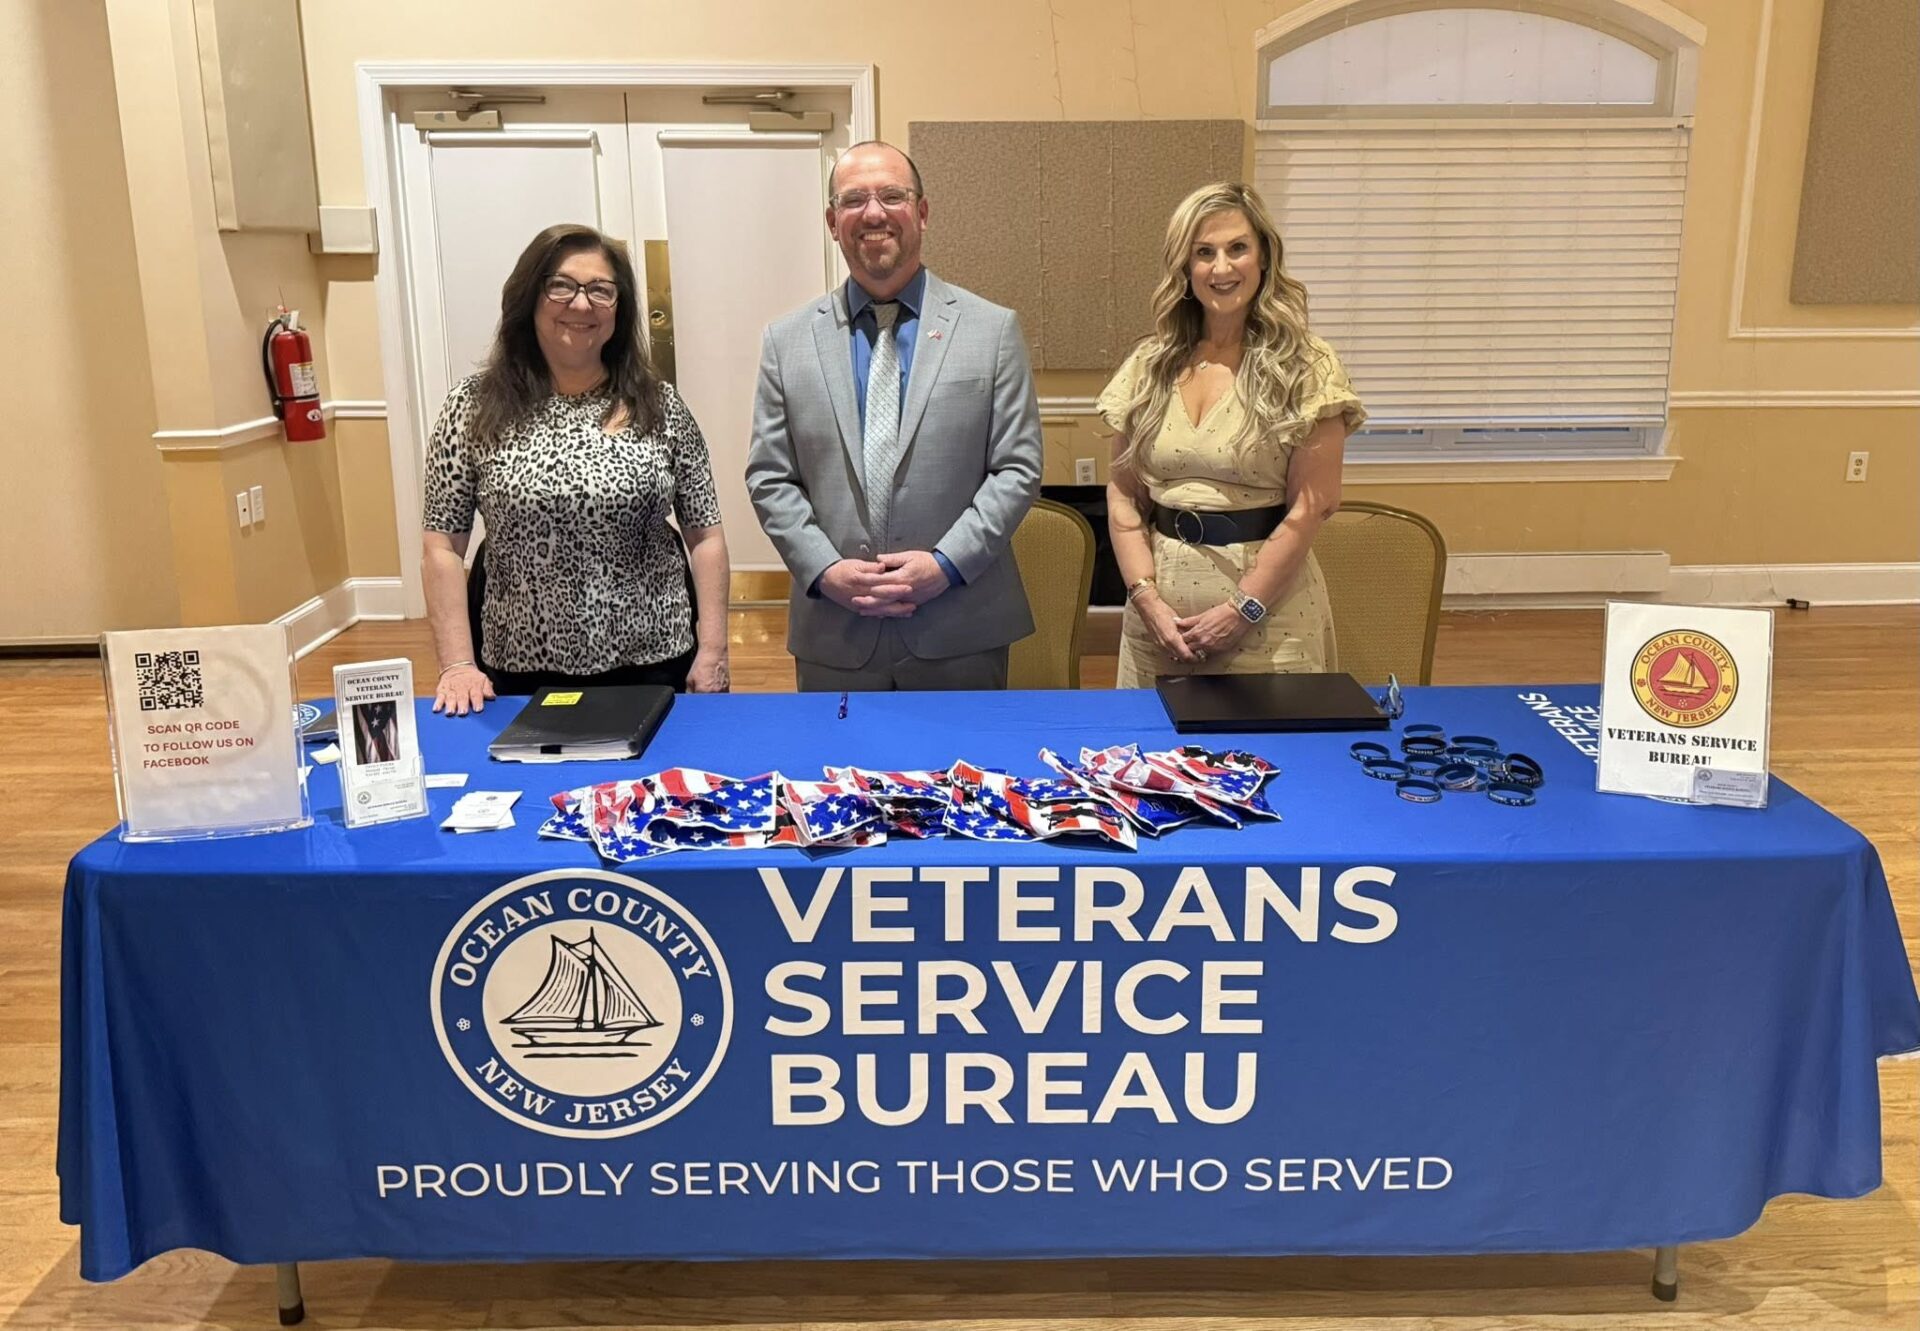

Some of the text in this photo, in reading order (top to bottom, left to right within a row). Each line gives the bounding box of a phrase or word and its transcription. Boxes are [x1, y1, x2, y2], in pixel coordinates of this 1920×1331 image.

[1641, 635, 1679, 665] OCEAN
[356, 684, 392, 692] VETERANS
[1646, 698, 1673, 718] NEW
[147, 720, 240, 735] SCAN QR CODE
[1607, 728, 1757, 752] VETERANS SERVICE
[144, 737, 254, 752] TO FOLLOW US ON
[1648, 750, 1712, 766] BUREAU
[143, 756, 210, 768] FACEBOOK
[757, 866, 1399, 945] VETERANS
[450, 887, 712, 987] OCEAN COUNTY
[764, 959, 1264, 1037] SERVICE
[475, 1056, 692, 1125] NEW JERSEY
[771, 1052, 1258, 1126] BUREAU
[377, 1156, 1453, 1198] PROUDLY SERVING THOSE WHO SERVED
